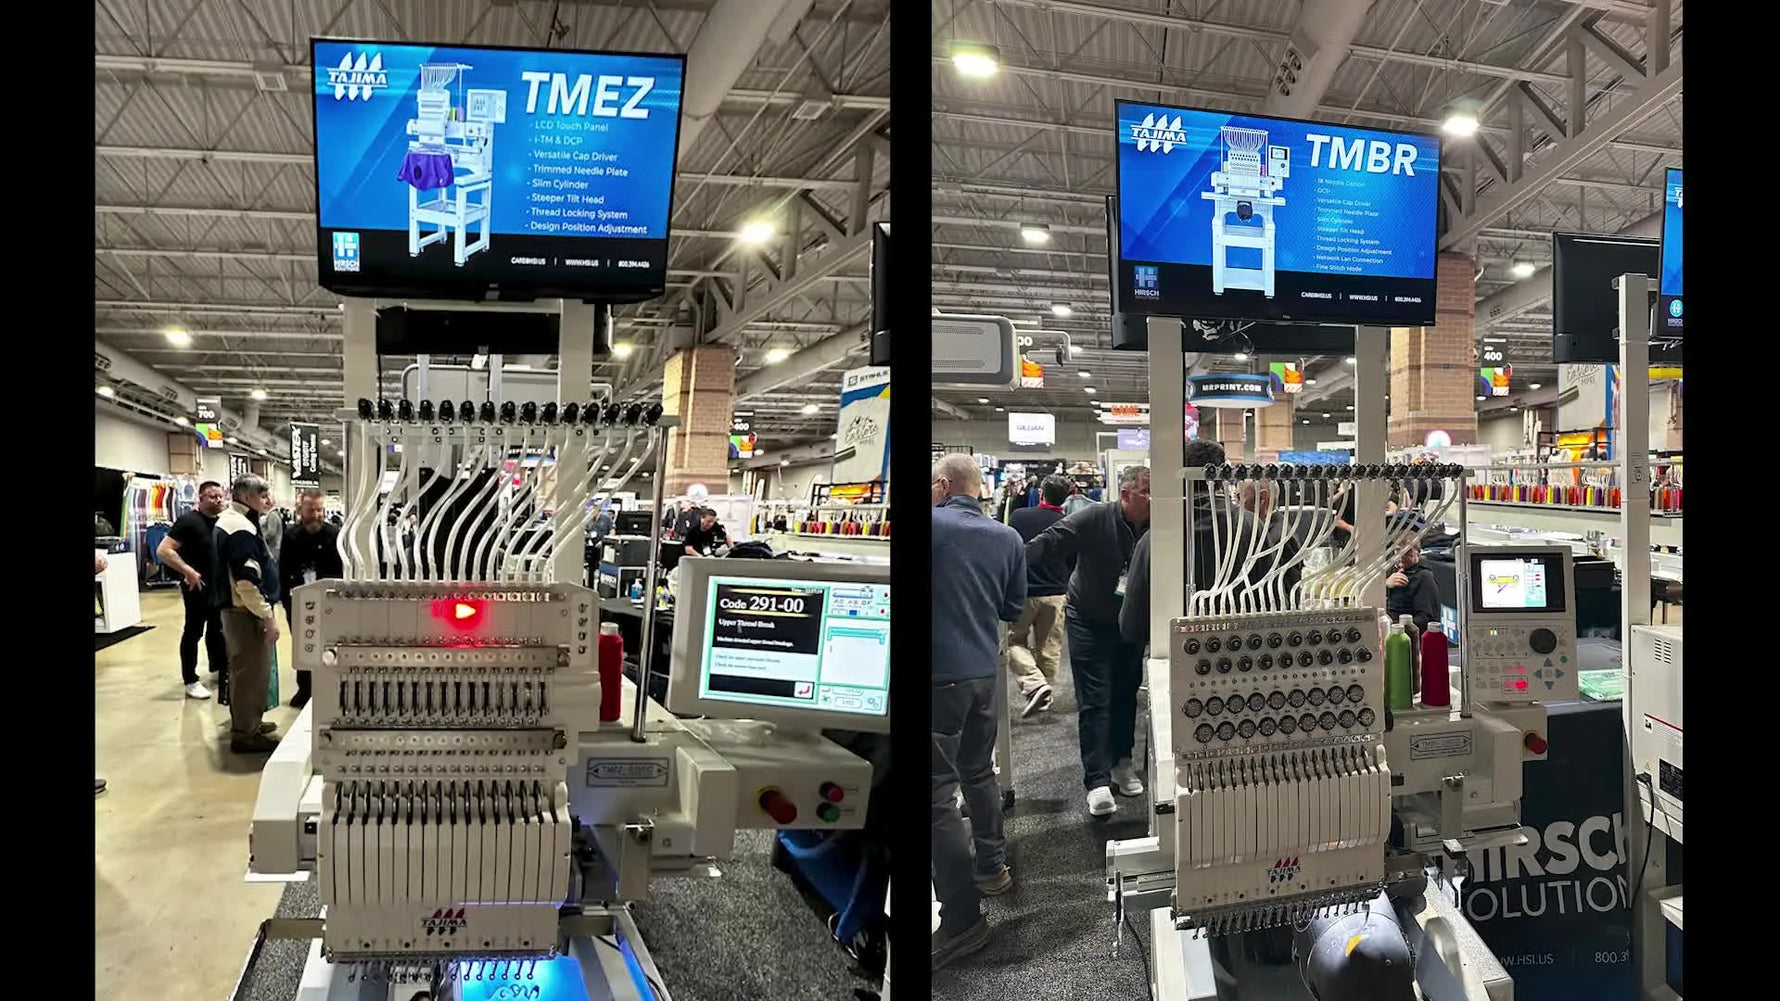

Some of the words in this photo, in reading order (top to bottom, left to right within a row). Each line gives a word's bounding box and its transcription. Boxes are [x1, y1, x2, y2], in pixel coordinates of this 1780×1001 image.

[328, 70, 387, 85] TAJIMA
[521, 71, 655, 119] TMEZ
[535, 120, 554, 130] LCD
[556, 120, 581, 132] Touch
[584, 121, 609, 132] Panel
[1131, 126, 1187, 143] TAJIMA
[555, 135, 562, 145] &
[563, 135, 584, 146] DCP
[533, 149, 571, 161] Versatile
[572, 150, 590, 163] Cap
[591, 151, 618, 162] Driver
[1305, 133, 1418, 177] TMBR
[533, 163, 572, 175] Trimmed
[573, 165, 604, 176] Needle
[606, 166, 629, 177] Plate
[532, 178, 552, 188] Slim
[553, 179, 589, 190] Cylinder
[531, 192, 565, 204] Steeper
[567, 193, 580, 204] Tilt
[582, 194, 605, 205] Head
[1317, 197, 1341, 205] Versatile
[1342, 198, 1354, 206] Cap
[1354, 199, 1371, 207] Driver
[531, 206, 561, 217] Thread
[562, 208, 596, 221] Locking
[597, 209, 629, 220] System
[1317, 206, 1342, 214] Trimmed
[1343, 208, 1364, 216] Needle
[530, 221, 561, 233] Design
[562, 222, 597, 233] Position
[598, 223, 648, 235] Adjustment
[1317, 235, 1336, 243] Thread
[1337, 236, 1359, 245] Locking
[1359, 238, 1380, 246] System
[1316, 244, 1337, 253] Design
[1337, 245, 1360, 254] Position
[1360, 247, 1392, 256] Adjustment
[334, 259, 359, 268] HIRSCH
[1316, 254, 1340, 262] Network
[1352, 256, 1383, 264] Connection
[1316, 263, 1329, 271] Fine
[1134, 289, 1160, 297] HIRSCH
[1017, 336, 1033, 346] 00
[1483, 351, 1502, 361] 400
[1202, 383, 1262, 392] MRPRINT.COM
[198, 410, 215, 419] 700
[291, 425, 302, 479] VASTEX
[720, 598, 747, 609] Code
[749, 595, 804, 613] 291-00
[718, 618, 737, 627] Upper
[737, 619, 757, 628] Thread
[757, 620, 775, 629] Break
[421, 918, 467, 928] TAJIMA
